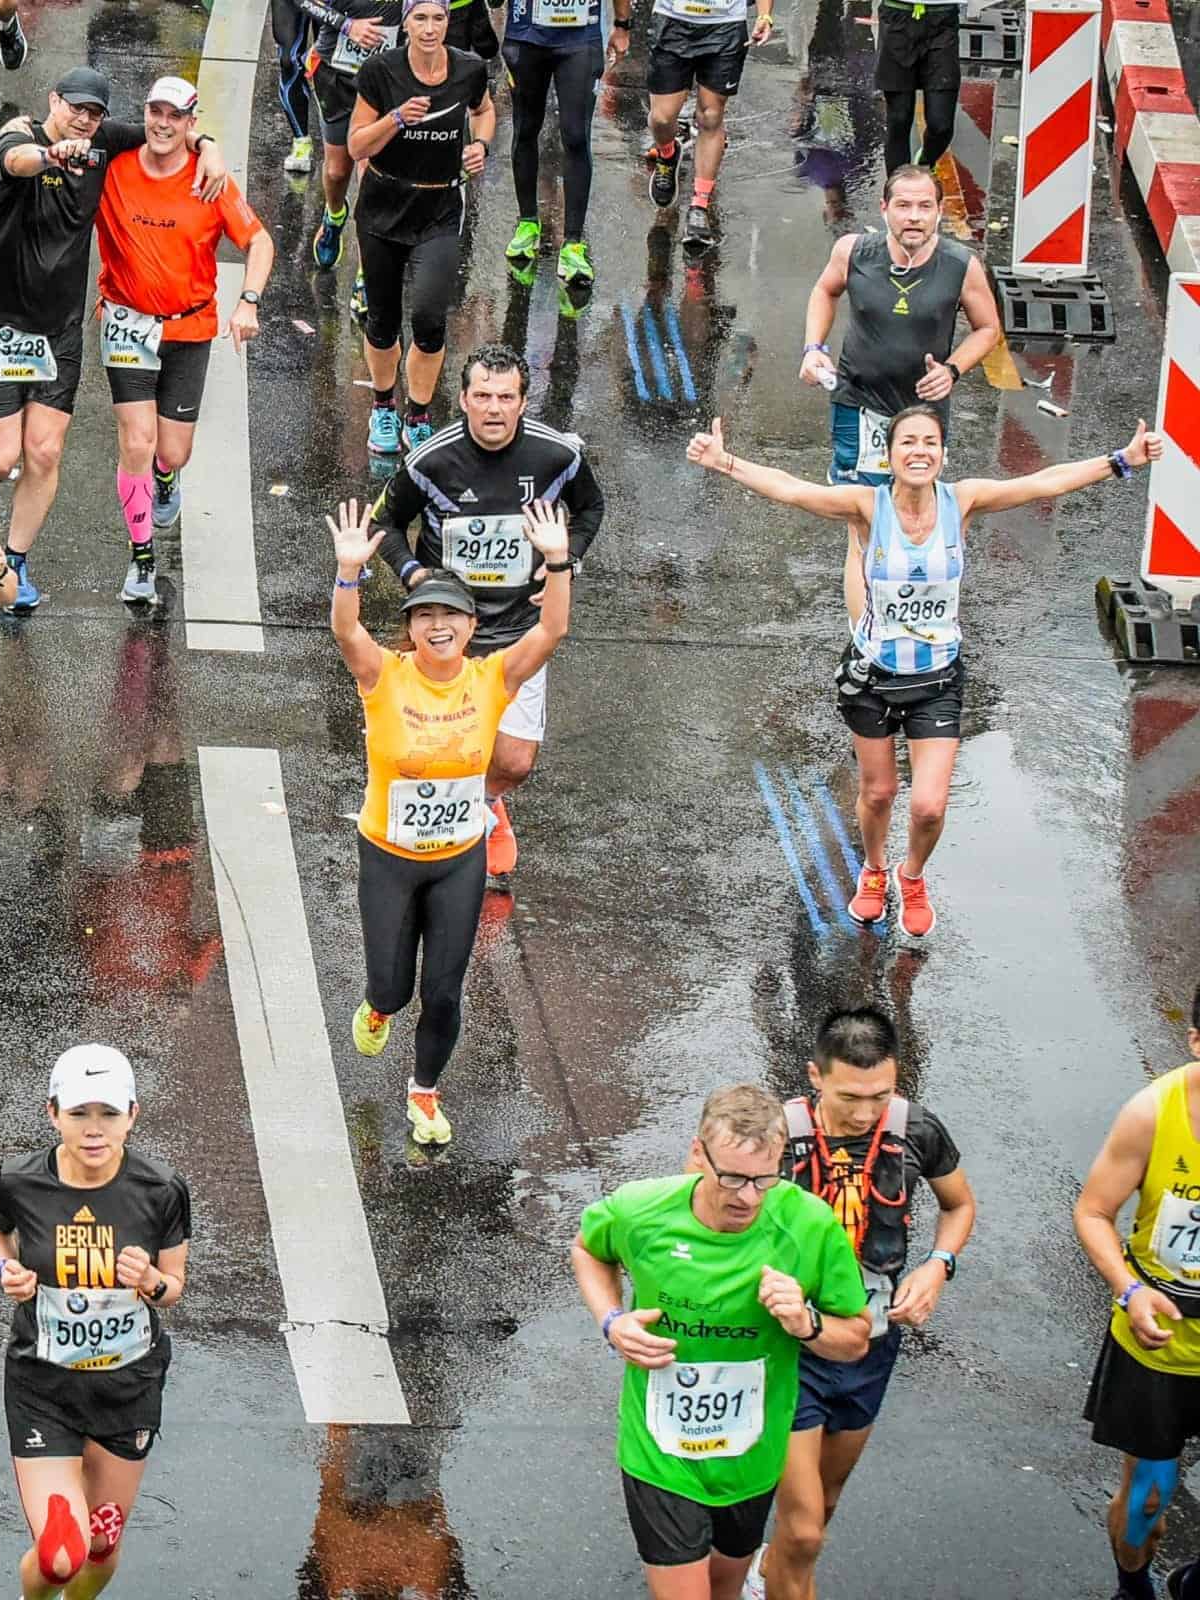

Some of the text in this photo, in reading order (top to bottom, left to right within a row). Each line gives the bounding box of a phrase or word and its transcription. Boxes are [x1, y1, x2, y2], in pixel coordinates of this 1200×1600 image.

[403, 129, 459, 140] JUST DO IT
[456, 539, 520, 560] 29125
[886, 600, 946, 623] 62986
[403, 800, 470, 827] 23292
[56, 1225, 113, 1247] BERLIN
[1168, 1224, 1200, 1250] 71
[56, 1248, 115, 1288] FIN
[57, 1312, 135, 1347] 50935
[656, 1312, 759, 1339] Andreas
[666, 1389, 745, 1423] 13591
[681, 1424, 723, 1436] Andreas
